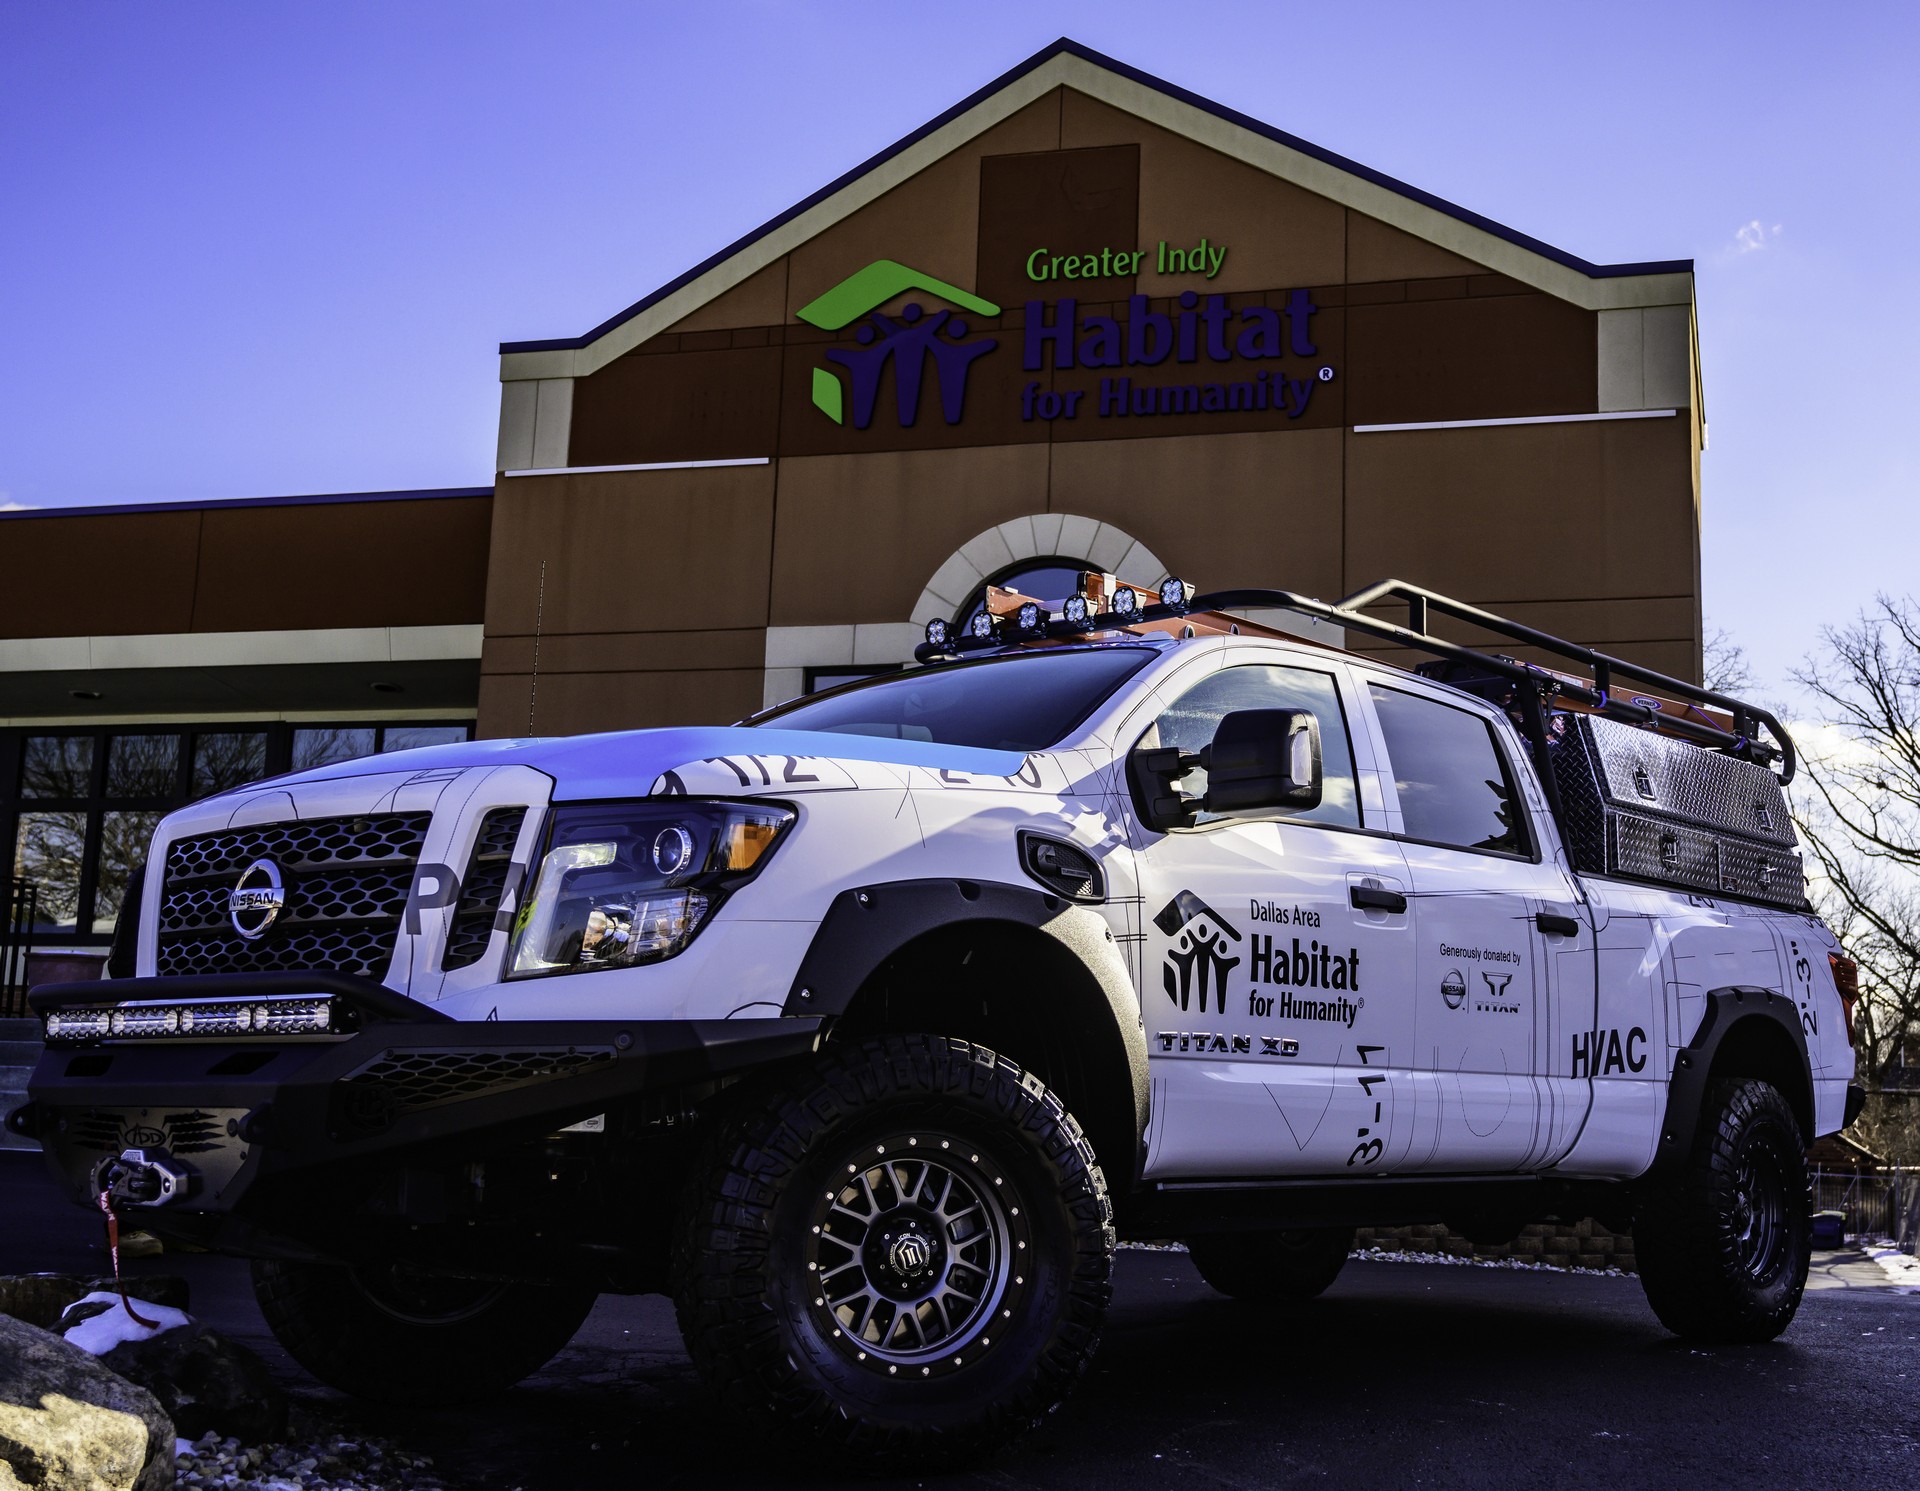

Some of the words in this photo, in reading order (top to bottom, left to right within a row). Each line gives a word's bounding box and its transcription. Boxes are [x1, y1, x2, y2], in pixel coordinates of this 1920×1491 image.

[1026, 247, 1146, 281] Greater
[1157, 238, 1226, 279] Indy
[1022, 289, 1318, 371] Habitat
[1022, 382, 1084, 421] for
[230, 892, 275, 908] NISSAN
[1250, 898, 1289, 924] Dallas
[1292, 904, 1321, 928] Area
[1250, 933, 1359, 991] Habitat
[1440, 943, 1481, 962] Generously
[1483, 948, 1511, 962] donated
[1513, 951, 1521, 966] by
[1249, 988, 1274, 1018] for
[1443, 984, 1464, 993] NISSAN
[1475, 1000, 1519, 1013] TITAN
[1157, 1031, 1251, 1054] TITAN
[1259, 1036, 1300, 1057] XD
[1571, 1026, 1647, 1080] HVAC
